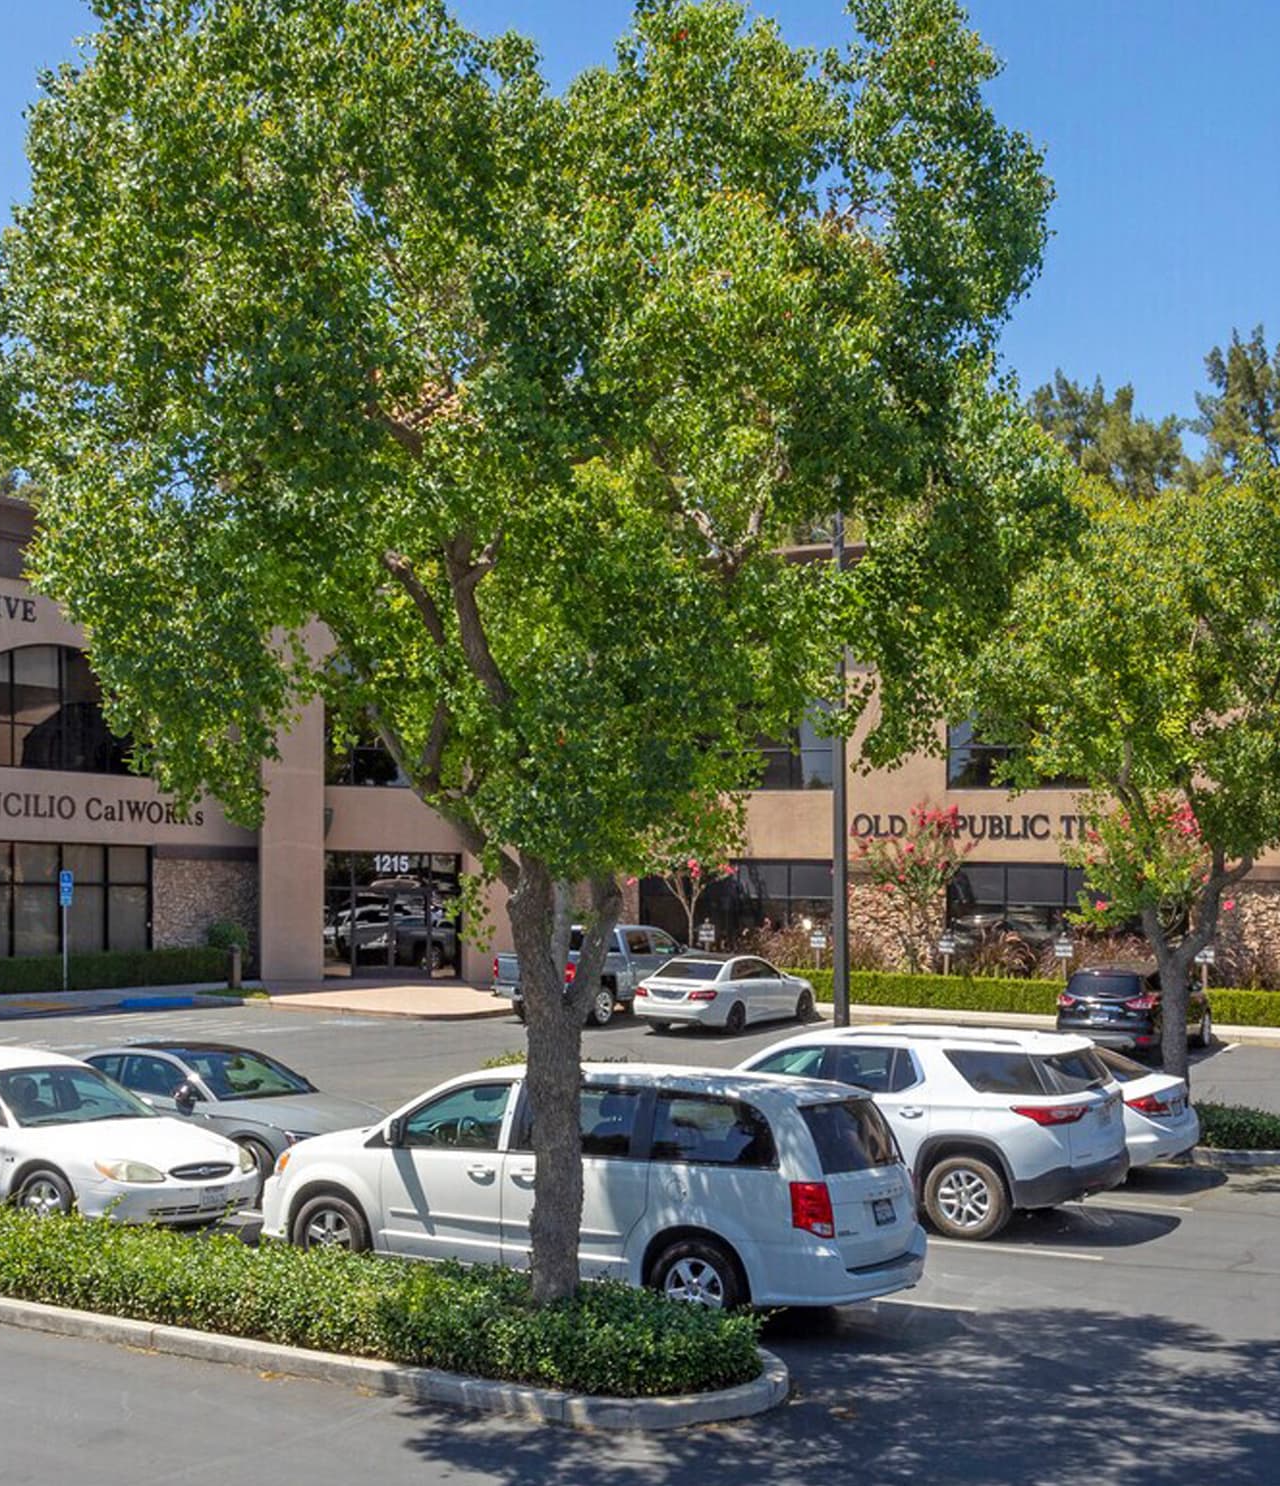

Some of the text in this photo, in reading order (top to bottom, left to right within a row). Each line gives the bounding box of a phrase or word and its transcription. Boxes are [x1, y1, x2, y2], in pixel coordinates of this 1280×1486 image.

[853, 814, 907, 839] OLD
[916, 814, 1051, 840] PUBLIC
[373, 854, 409, 873] 1215
